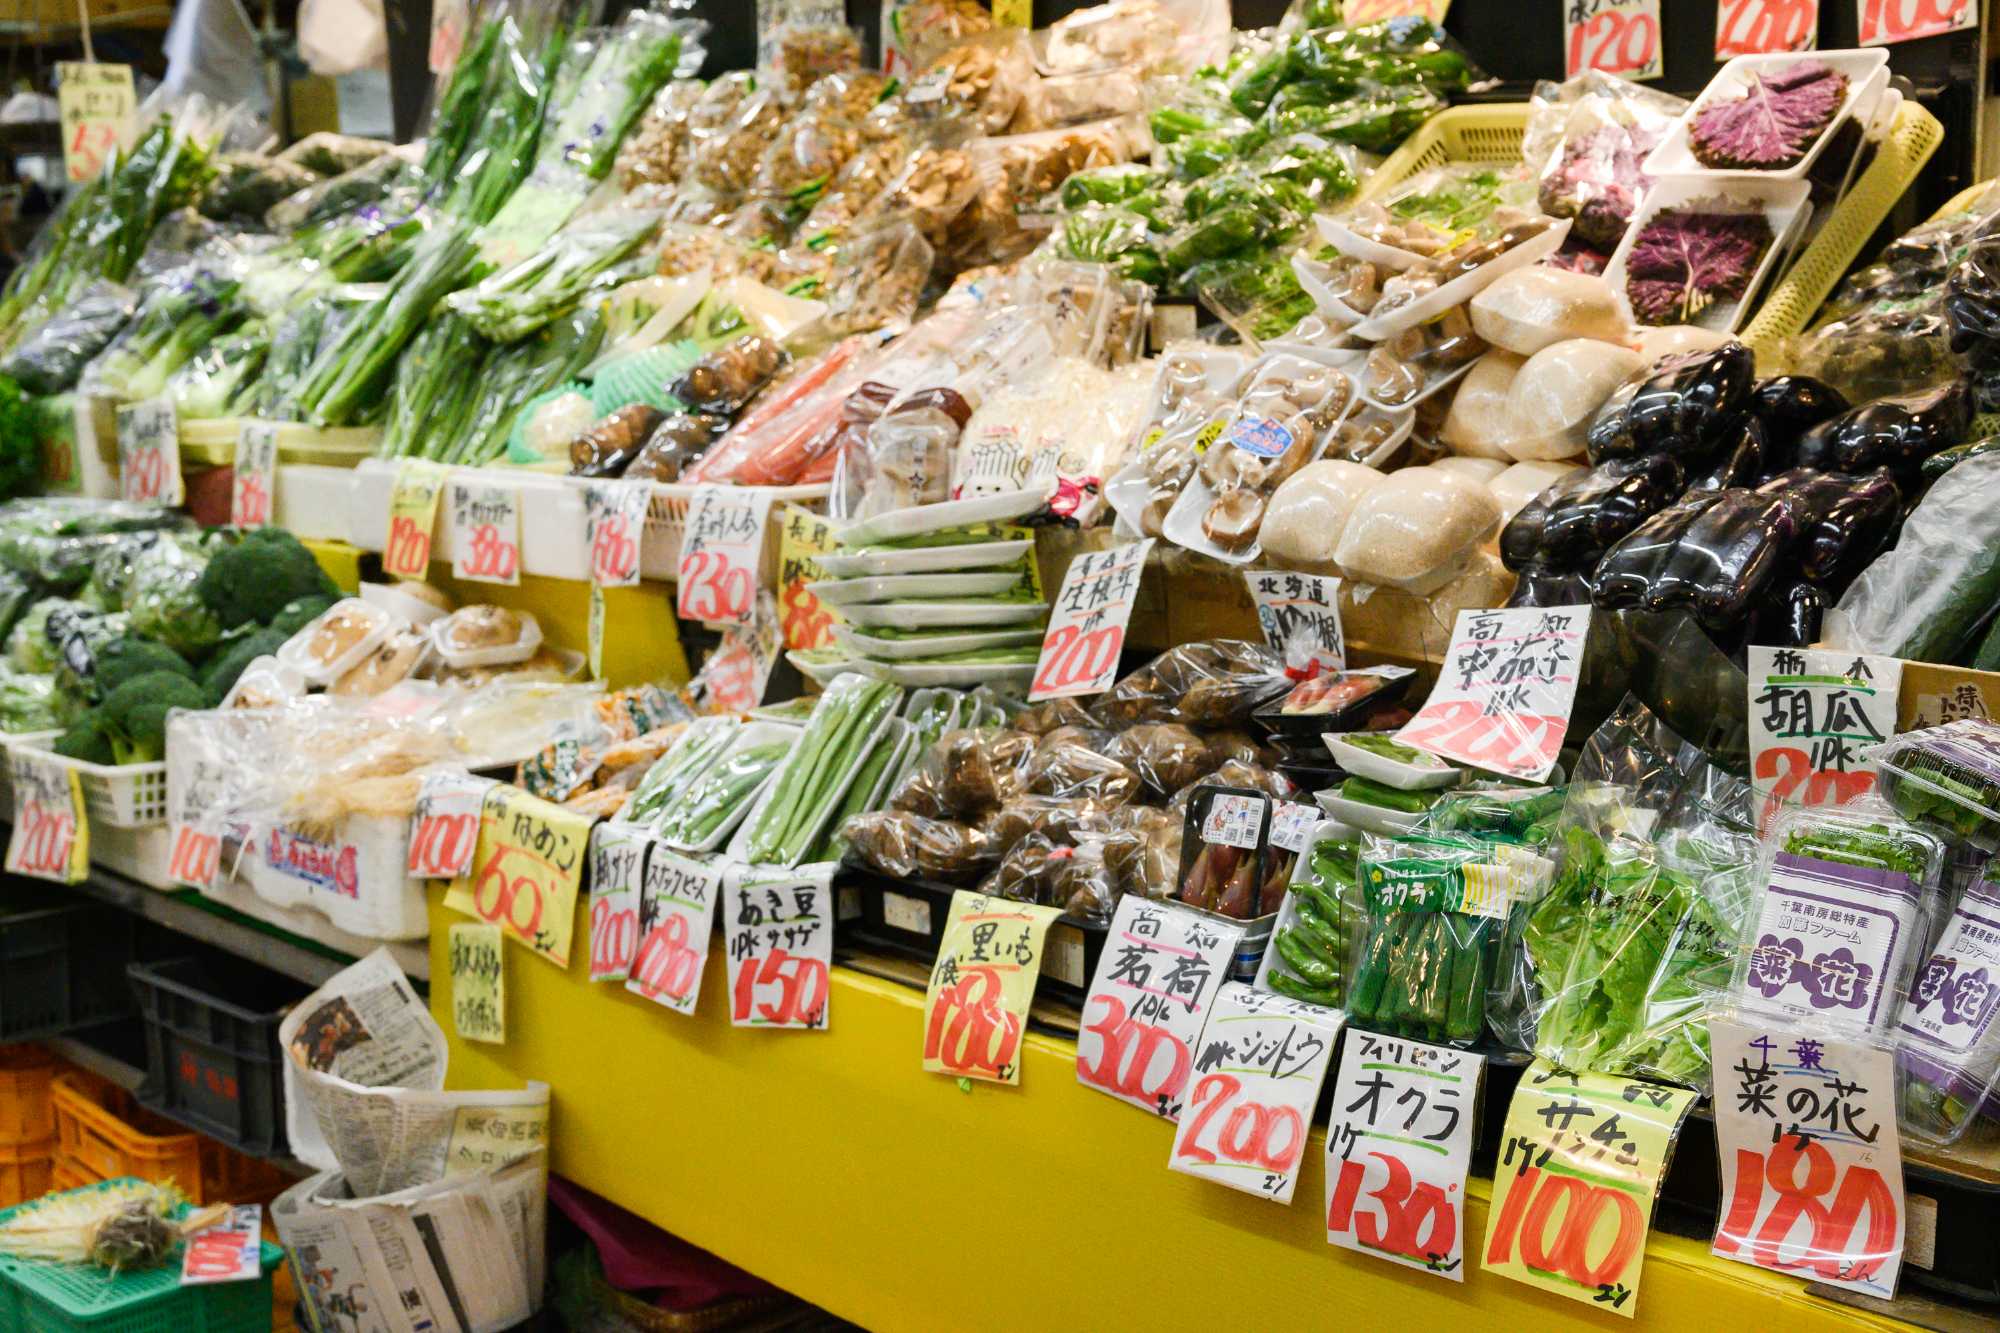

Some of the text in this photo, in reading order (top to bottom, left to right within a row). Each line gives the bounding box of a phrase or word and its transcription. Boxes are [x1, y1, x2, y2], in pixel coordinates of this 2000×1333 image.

[680, 551, 753, 620] 230
[1258, 575, 1329, 607] 北海道
[1030, 624, 1123, 693] 200
[1754, 685, 1887, 743] 胡瓜
[409, 814, 477, 875] 100
[512, 811, 577, 872] なめこ
[473, 844, 544, 940] 60
[1381, 881, 1425, 906] オクラ
[1781, 900, 1871, 930] 千葉南房総特産
[591, 896, 639, 975] 200
[629, 912, 700, 998] 180
[968, 922, 1033, 966] 里いも
[734, 948, 829, 1025] 150
[1107, 944, 1212, 1013] 茗荷
[1756, 944, 1860, 1003] 菜花
[924, 967, 1021, 1073] 180
[1077, 994, 1191, 1105] 300
[1748, 1035, 1826, 1073] 千葉
[1178, 1074, 1305, 1175] 200
[1346, 1071, 1460, 1141] オクラ
[1733, 1058, 1880, 1143] 菜の花
[1327, 1151, 1457, 1261] 130
[1487, 1166, 1643, 1289] 100
[1714, 1132, 1897, 1283] 180
